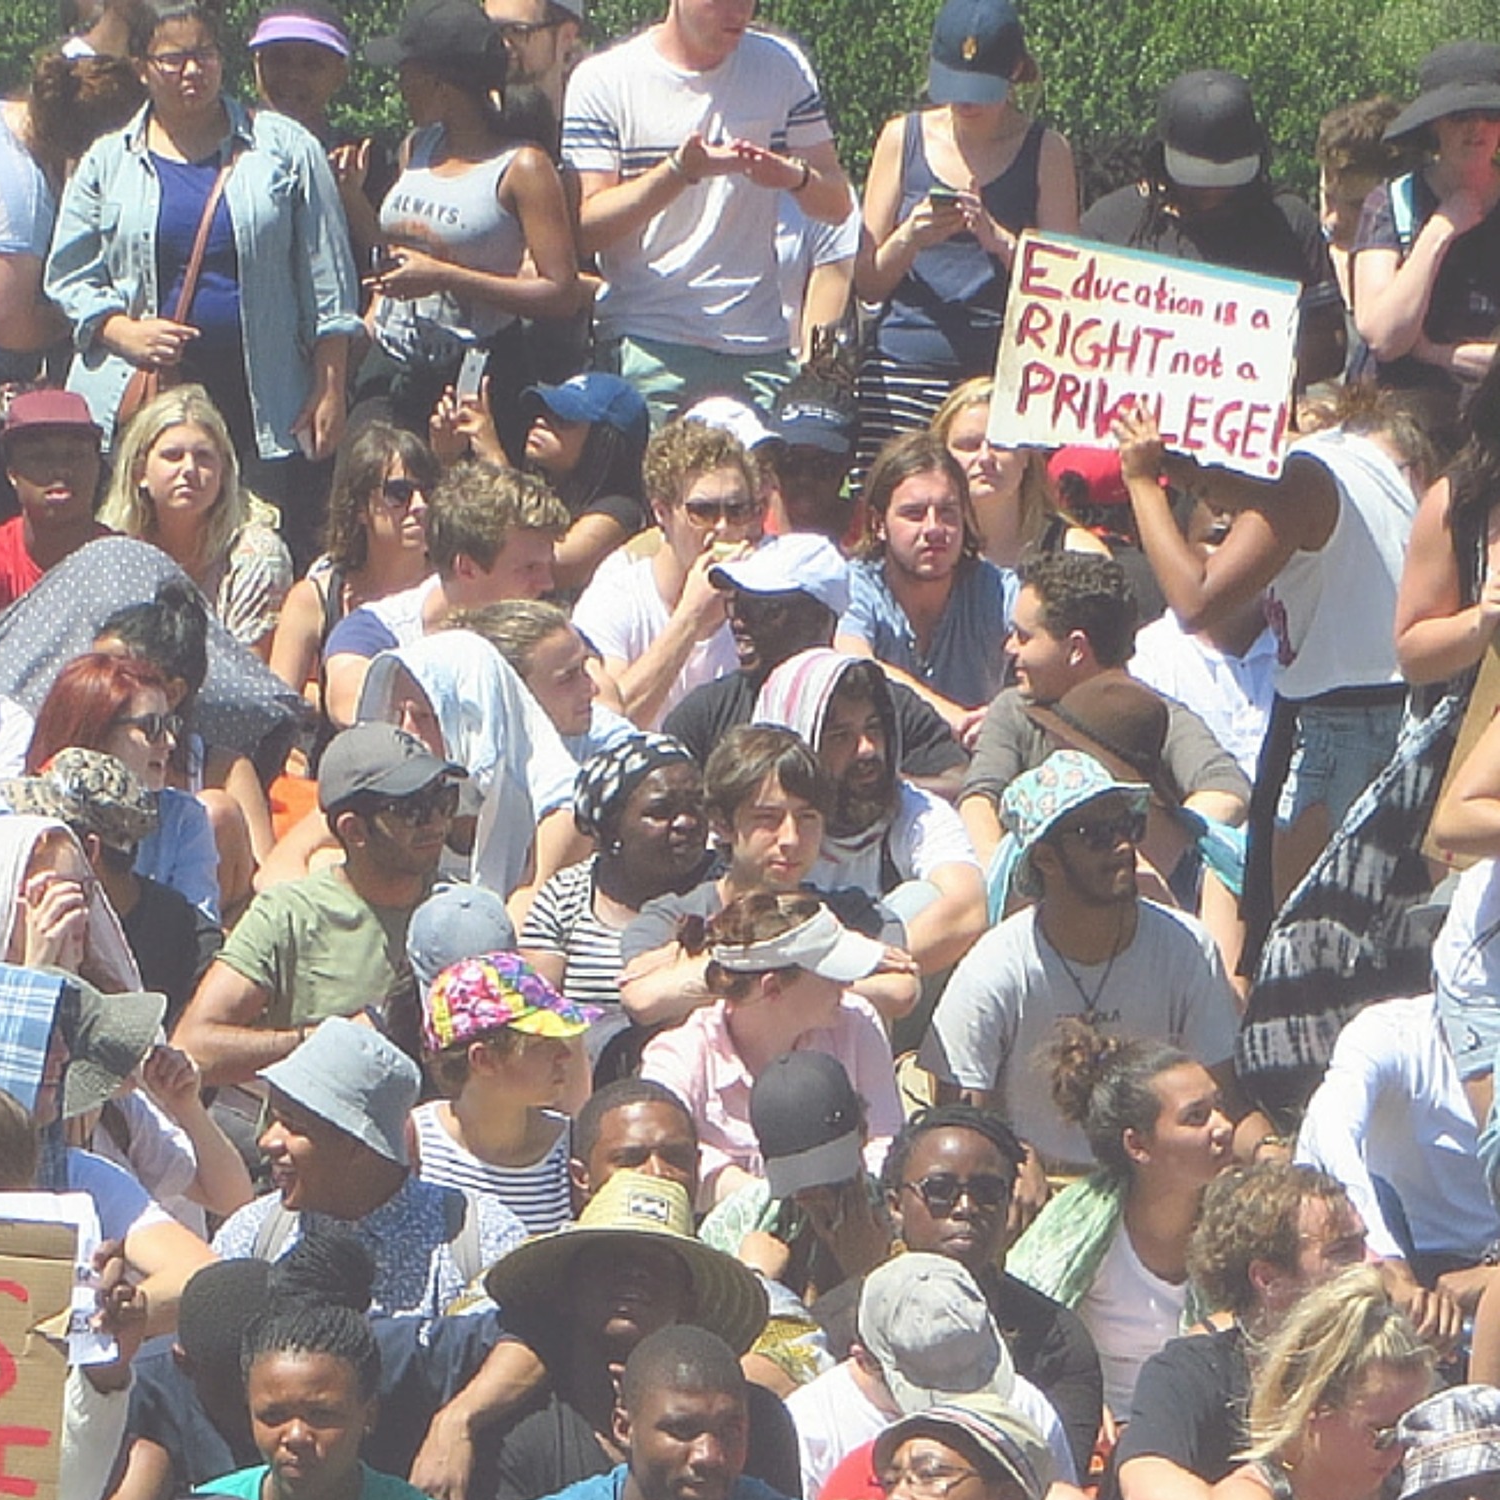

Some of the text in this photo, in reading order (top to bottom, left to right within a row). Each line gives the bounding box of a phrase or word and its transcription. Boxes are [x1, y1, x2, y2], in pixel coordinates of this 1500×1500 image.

[1020, 240, 1203, 317] Education
[1251, 309, 1271, 330] a
[1015, 302, 1260, 380] RIGHT not a
